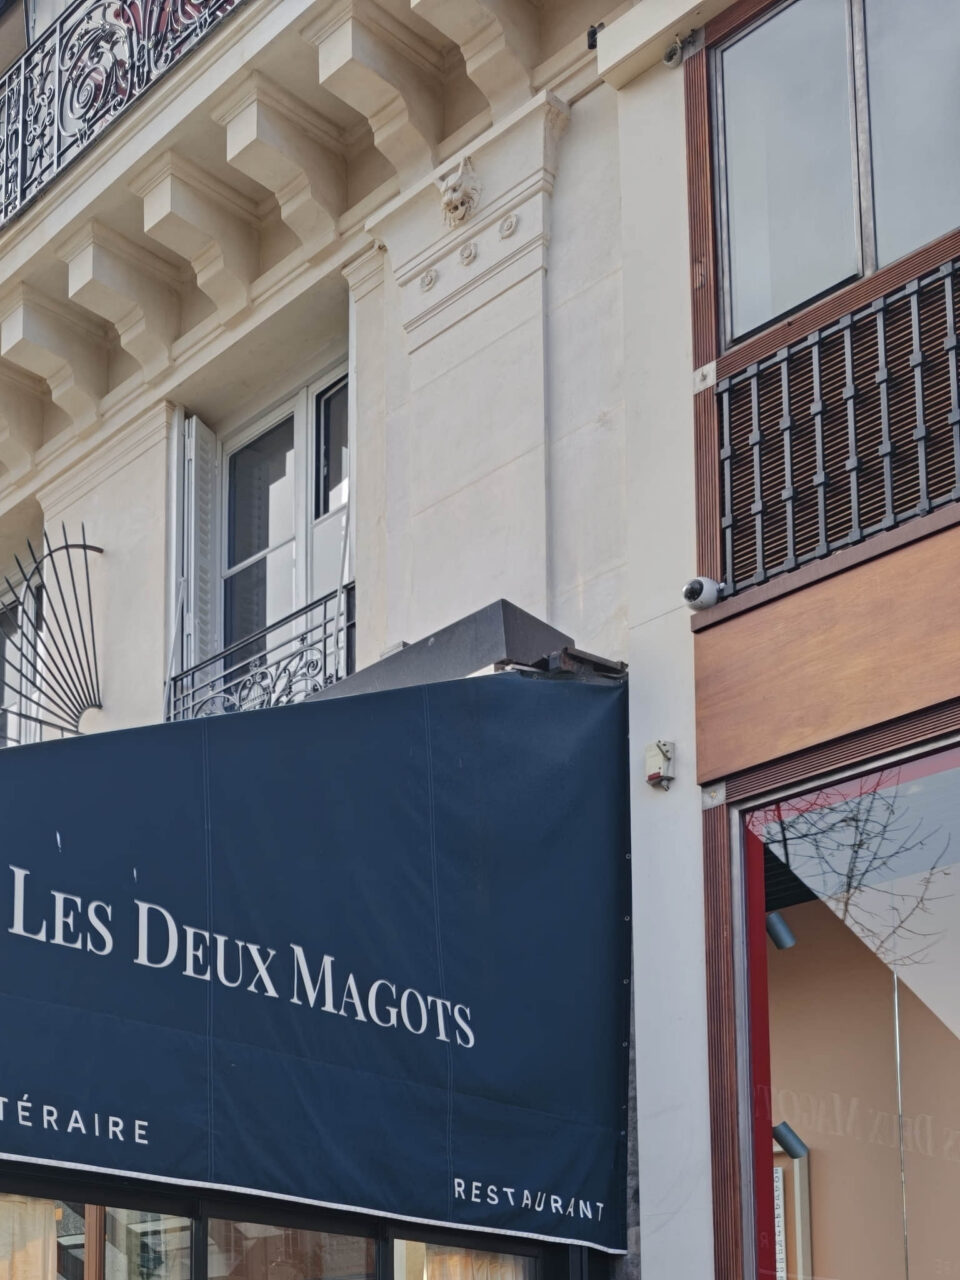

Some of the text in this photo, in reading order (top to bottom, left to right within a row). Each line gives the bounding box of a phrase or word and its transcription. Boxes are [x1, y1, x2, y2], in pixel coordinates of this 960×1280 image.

[7, 863, 475, 1049] LES DEUX MAGOTS
[453, 1177, 604, 1223] RESTAURANT
